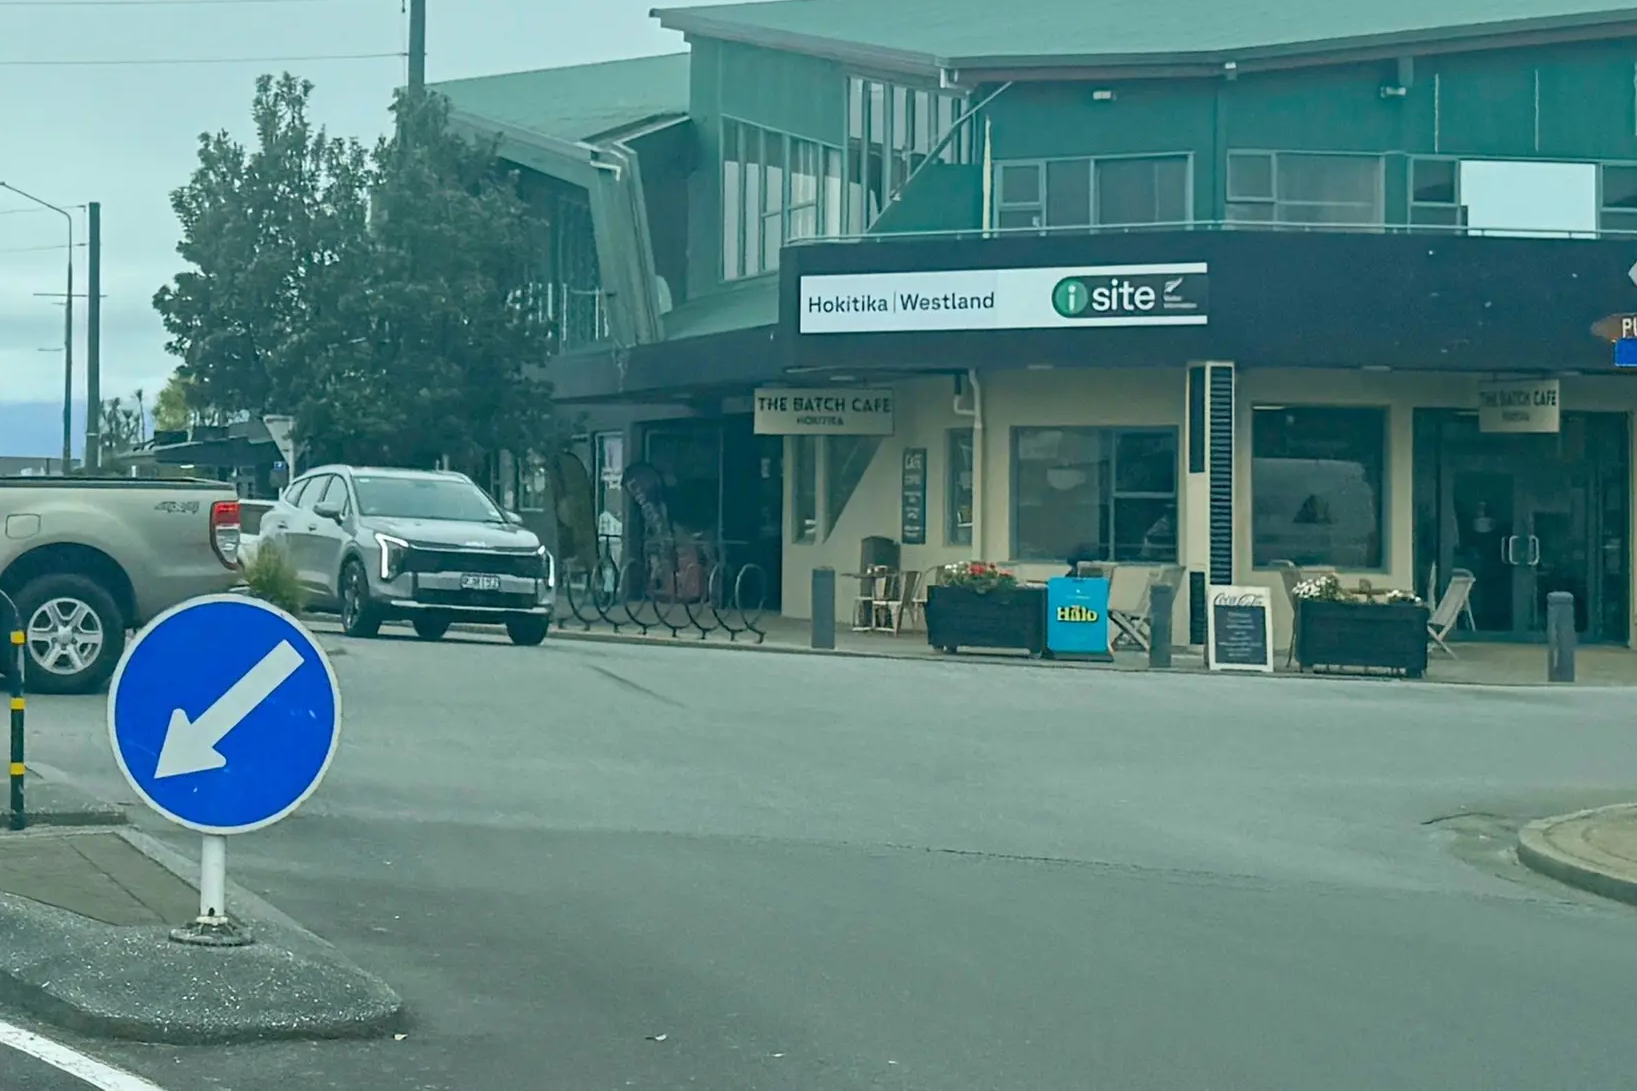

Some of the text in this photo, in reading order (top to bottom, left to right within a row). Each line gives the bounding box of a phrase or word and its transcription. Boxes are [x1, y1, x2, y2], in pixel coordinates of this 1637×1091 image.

[808, 291, 995, 313] Hokitika Westland
[1091, 278, 1156, 311] site
[758, 397, 892, 413] THE BATCH CAFE
